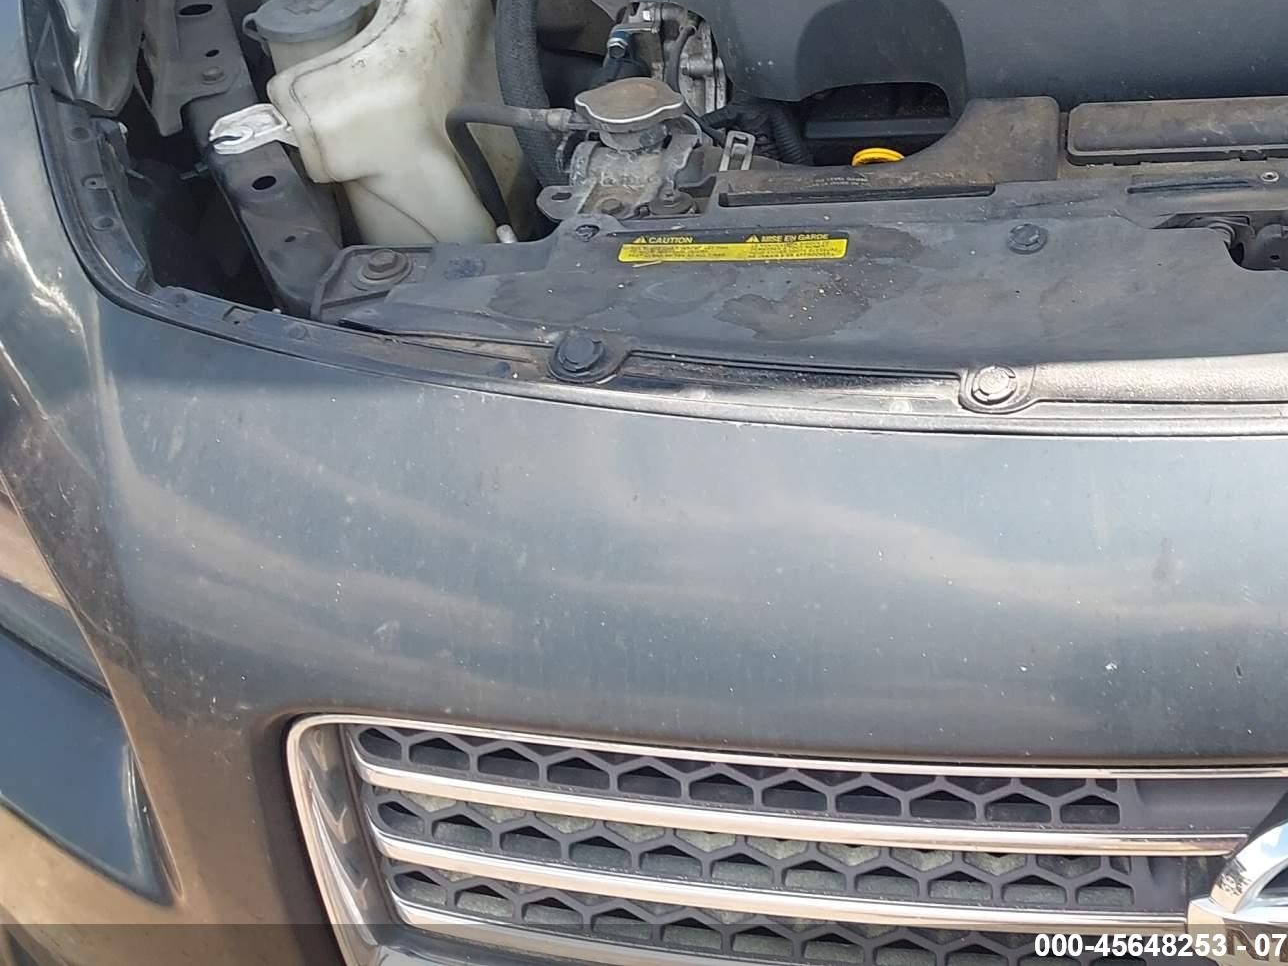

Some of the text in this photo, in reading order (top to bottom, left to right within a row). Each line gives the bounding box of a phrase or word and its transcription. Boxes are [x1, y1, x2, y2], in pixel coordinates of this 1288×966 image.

[648, 236, 693, 244] CAUTION
[761, 233, 829, 243] MISE EN GARDE
